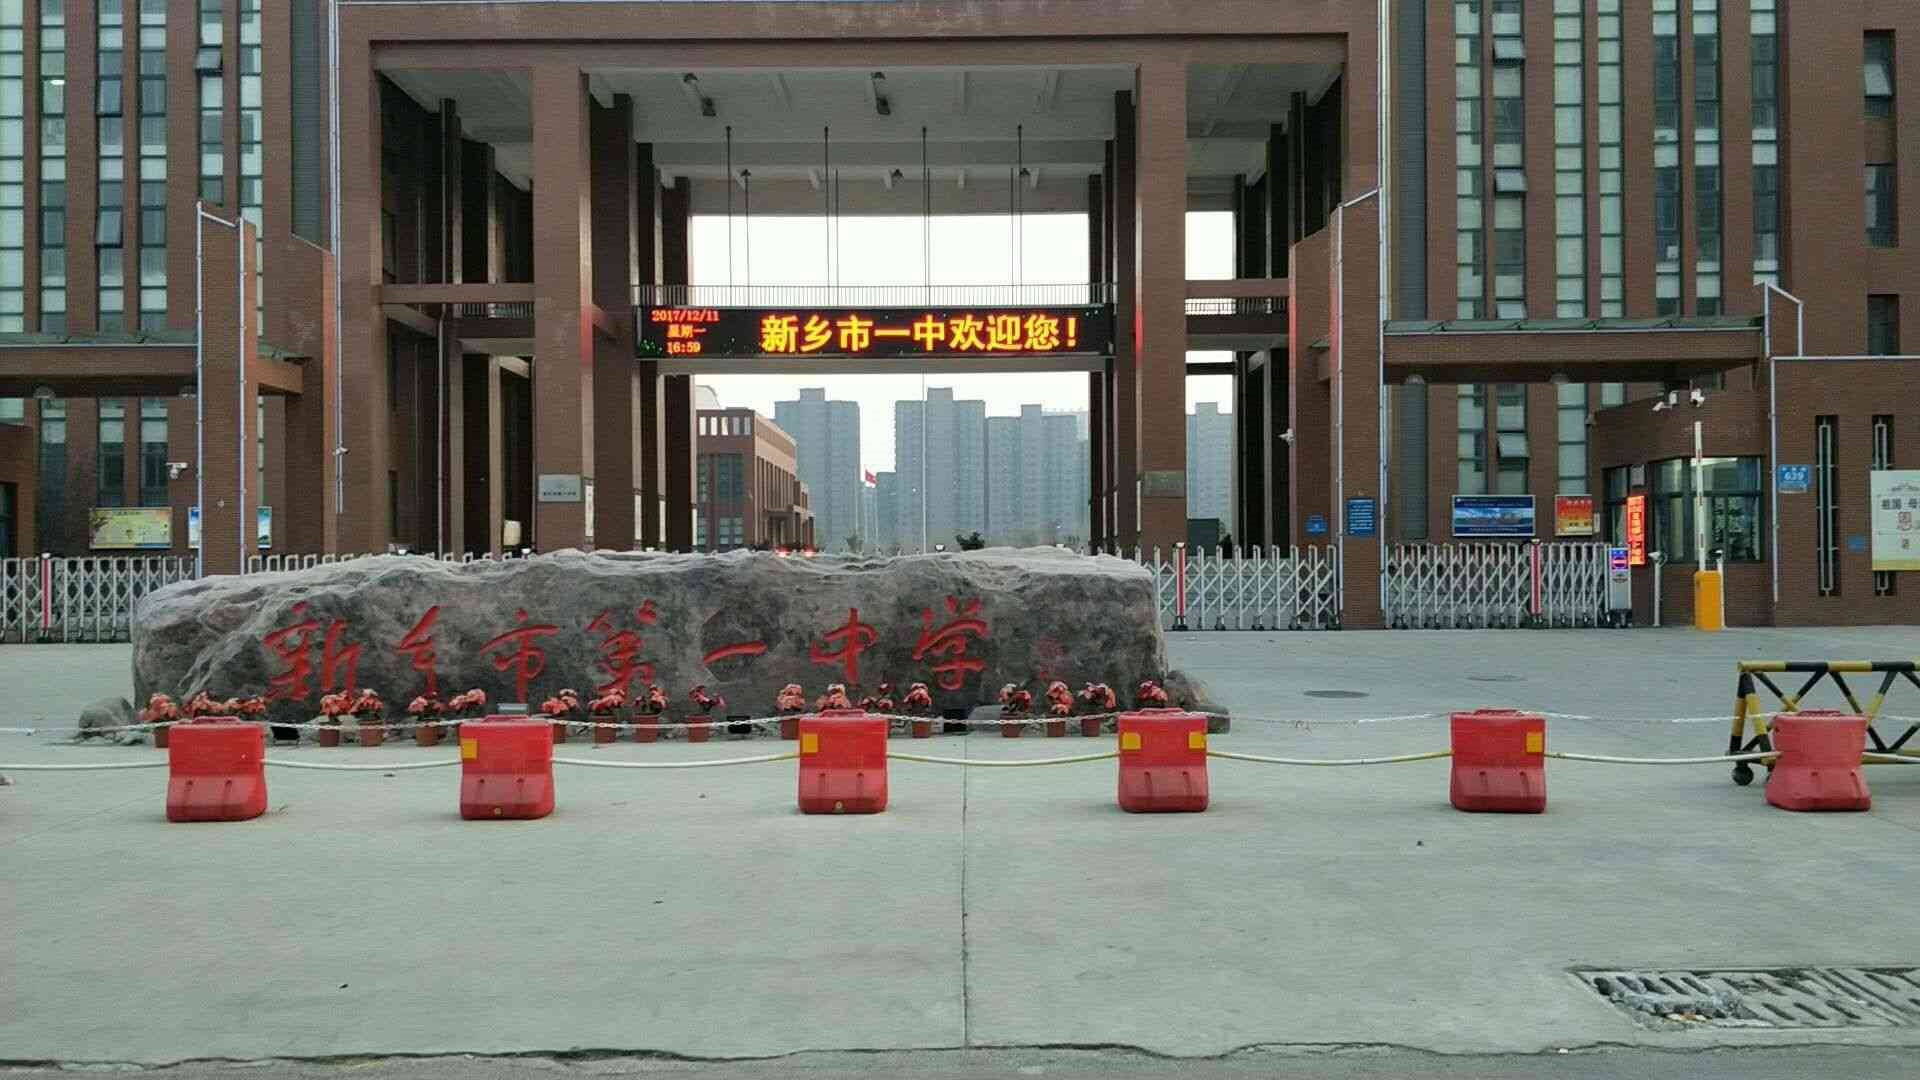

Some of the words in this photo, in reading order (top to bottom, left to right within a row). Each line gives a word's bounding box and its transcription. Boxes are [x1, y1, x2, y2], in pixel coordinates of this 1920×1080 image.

[651, 309, 720, 322] 2017/12/11
[667, 325, 708, 338] 星期一
[666, 342, 702, 353] 16:59
[264, 596, 991, 703] 新乡市第一中学
